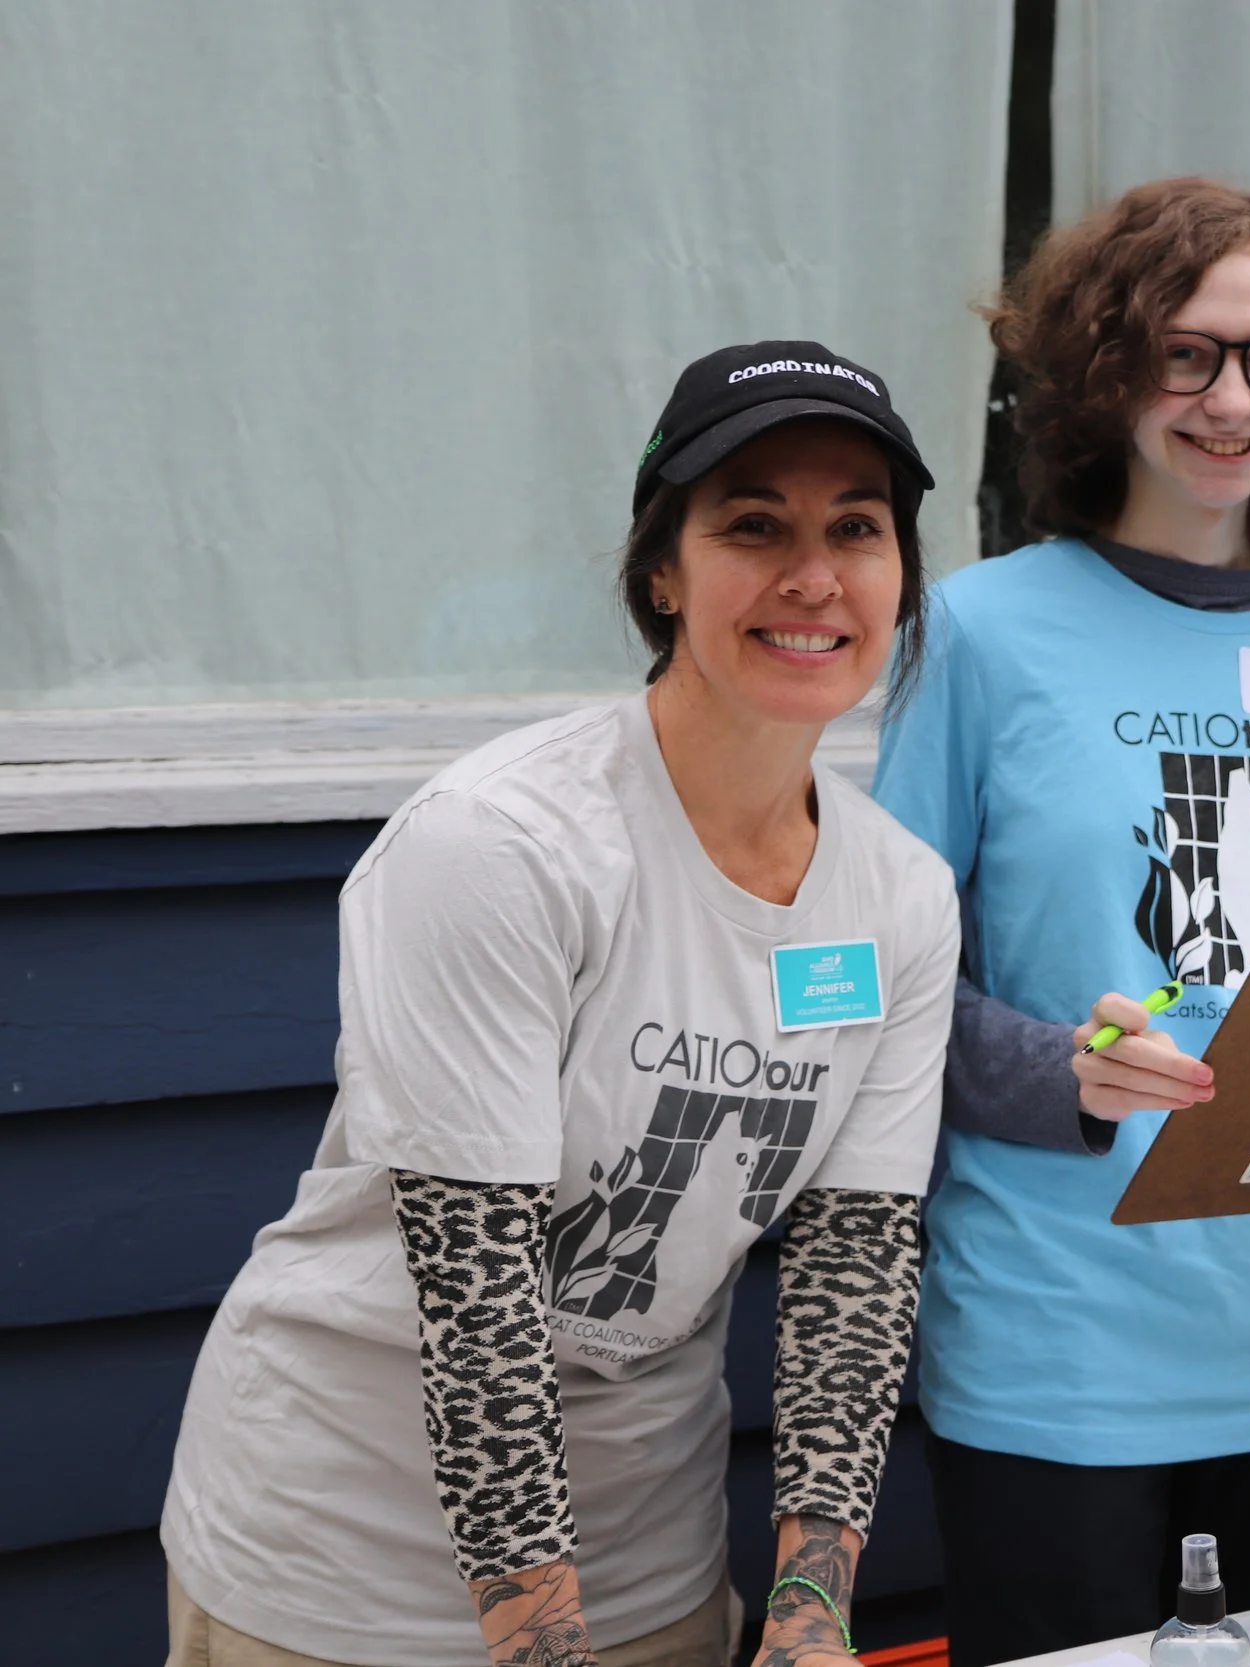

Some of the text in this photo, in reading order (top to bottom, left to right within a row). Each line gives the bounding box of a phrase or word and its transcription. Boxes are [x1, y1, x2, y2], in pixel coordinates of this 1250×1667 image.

[728, 360, 880, 397] COORDINATOR
[803, 981, 855, 997] JENNIFER
[547, 1315, 572, 1333] CAT
[573, 1322, 647, 1348] COALITION
